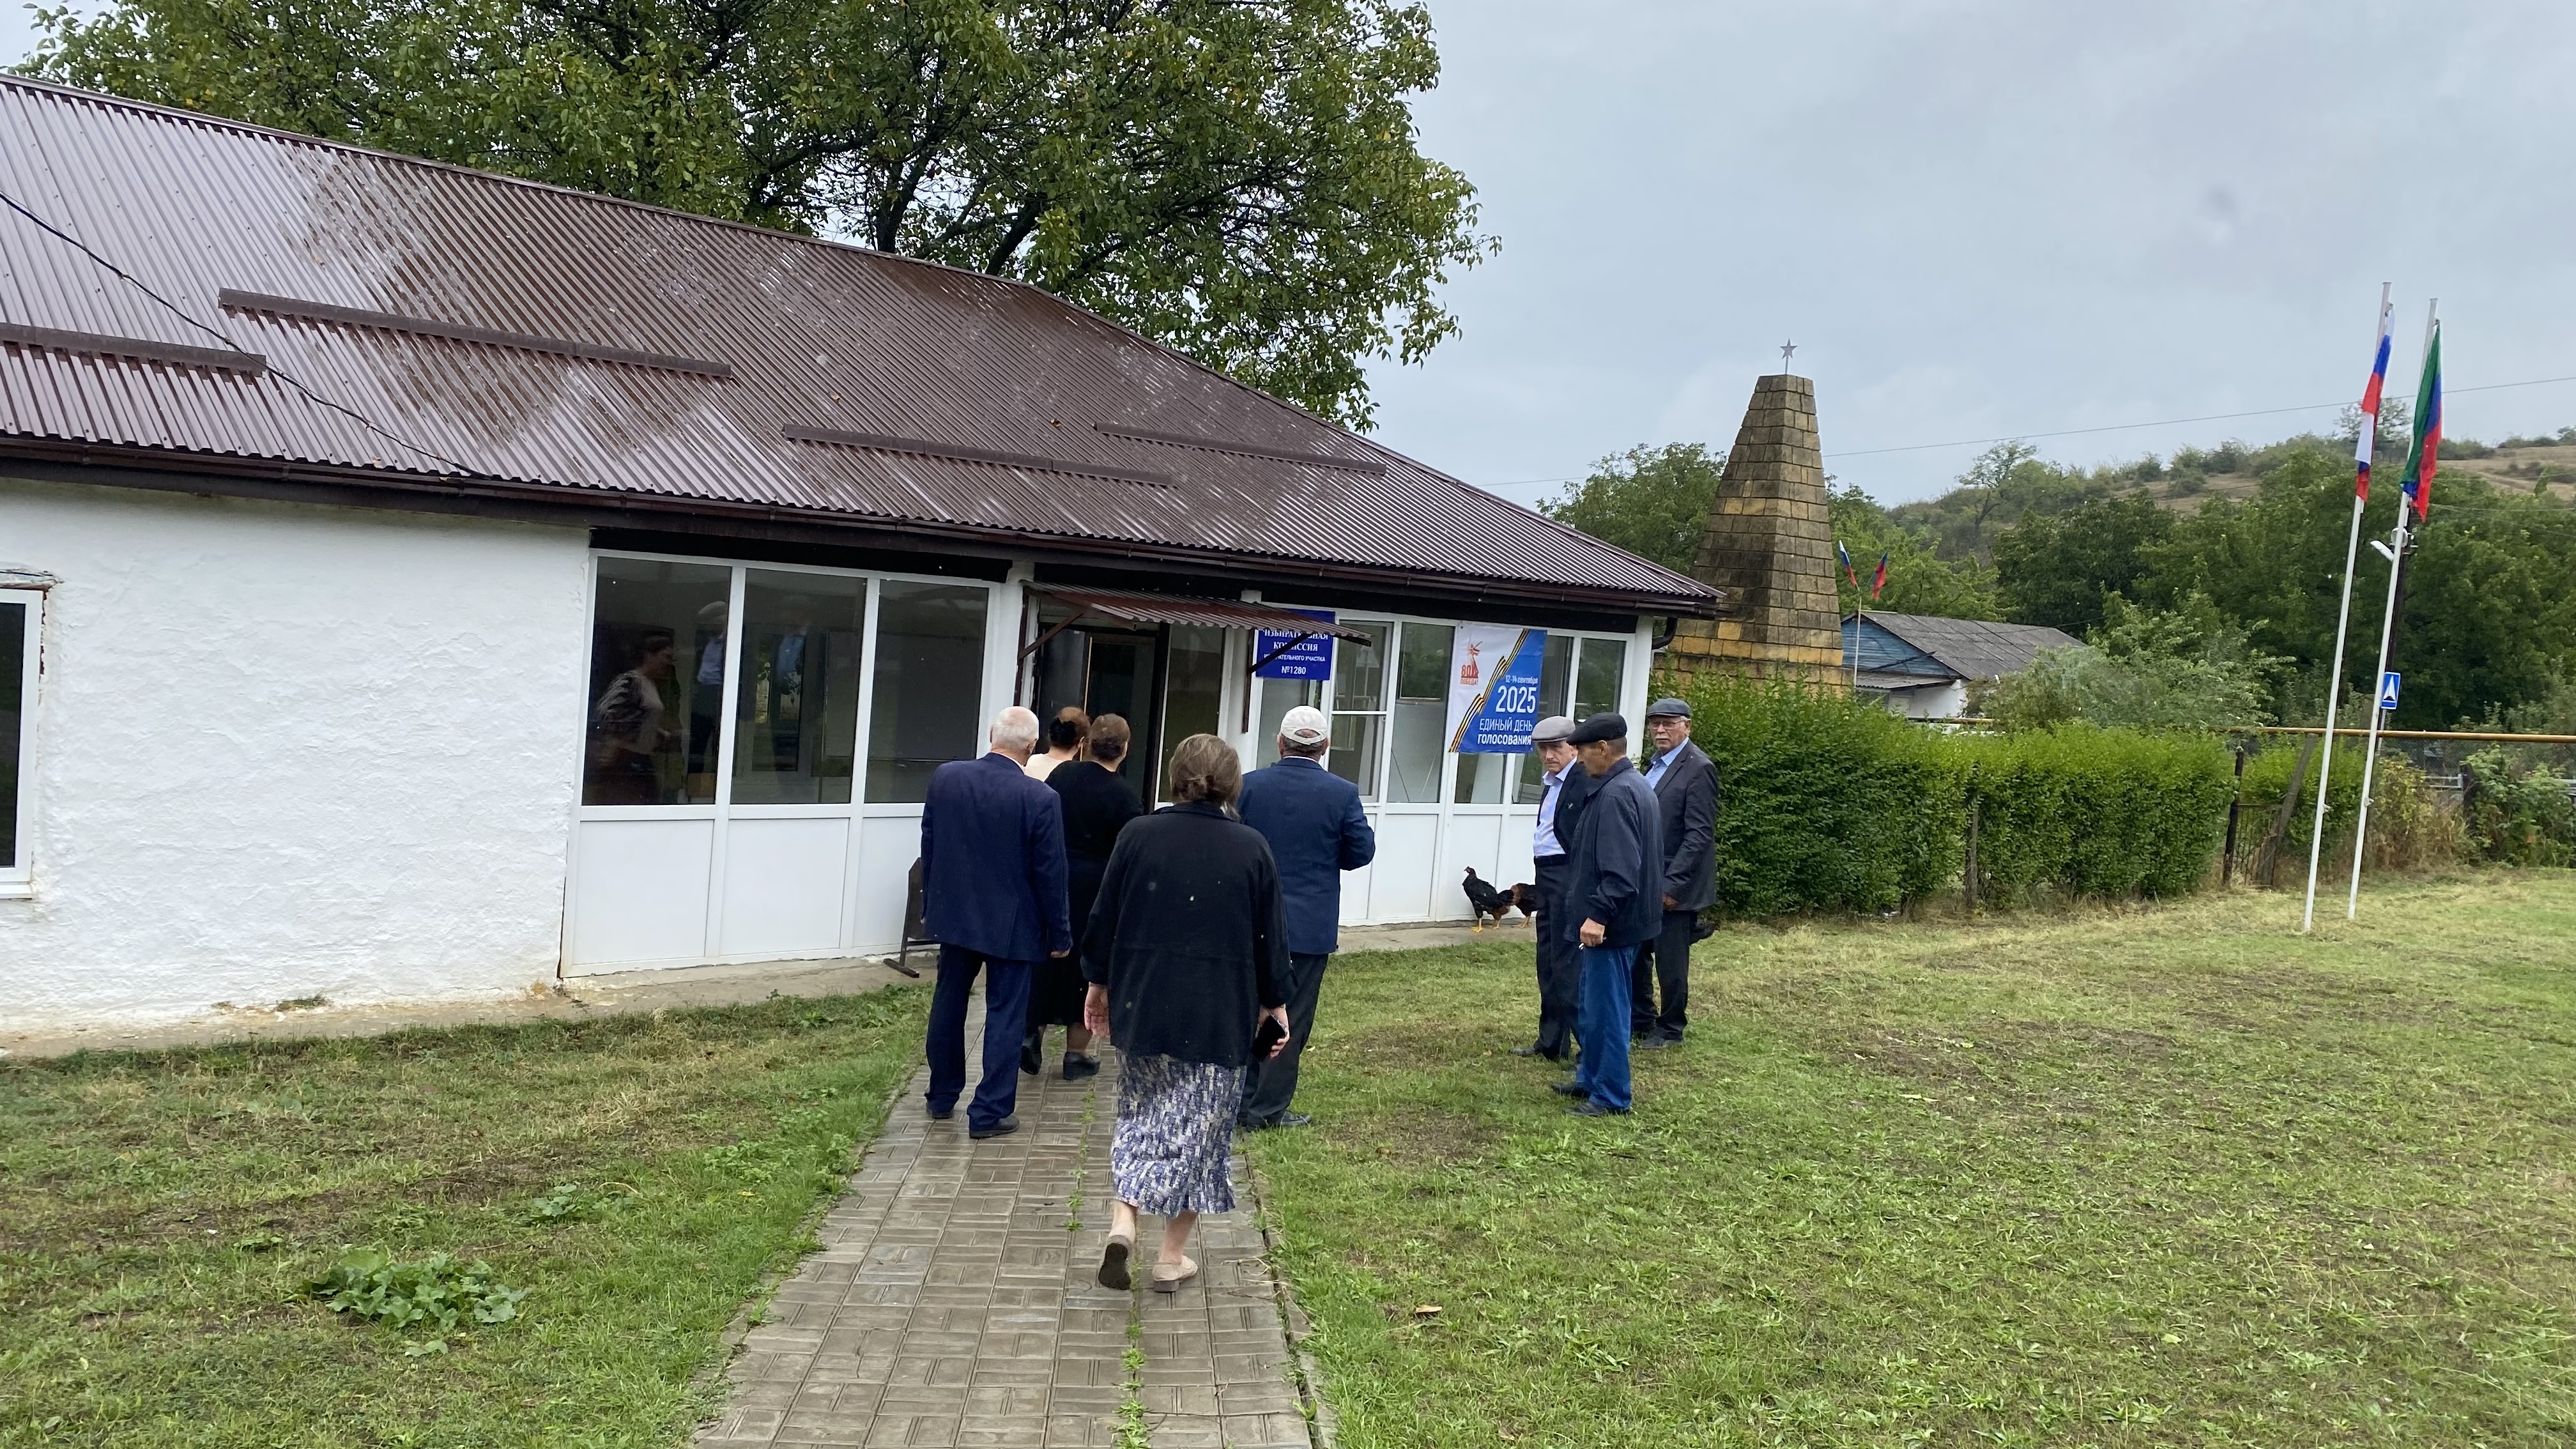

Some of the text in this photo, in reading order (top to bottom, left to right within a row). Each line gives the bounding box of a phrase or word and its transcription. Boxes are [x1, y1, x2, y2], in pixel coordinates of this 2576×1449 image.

[1282, 666, 1306, 674] №1280
[1505, 675, 1517, 683] 12-14
[1495, 685, 1537, 714] 2025
[1479, 716, 1533, 733] ЕДИНЫЙ ДЕНЬ
